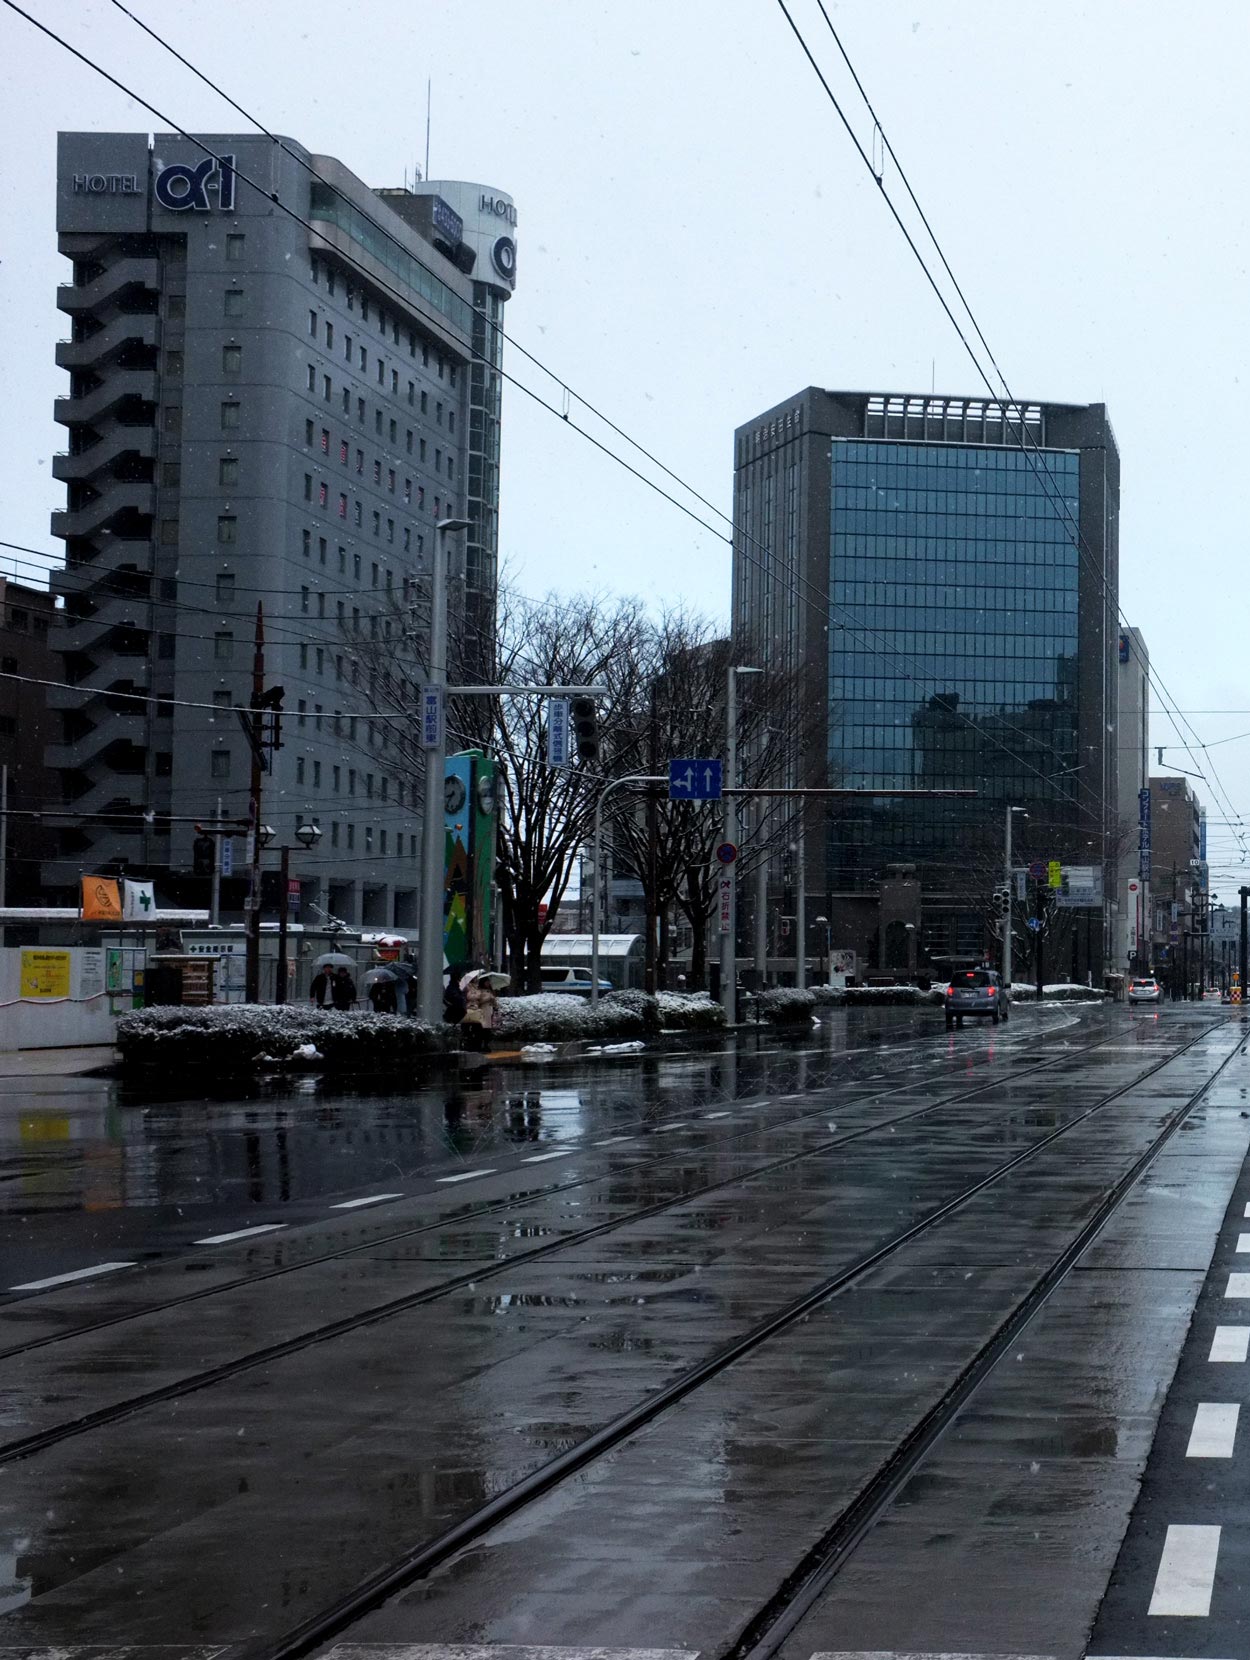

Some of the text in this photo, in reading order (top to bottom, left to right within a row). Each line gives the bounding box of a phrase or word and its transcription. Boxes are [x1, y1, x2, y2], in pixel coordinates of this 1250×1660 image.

[72, 173, 144, 194] HOTEL
[425, 695, 437, 743] 富山駅前東
[1129, 952, 1136, 960] P
